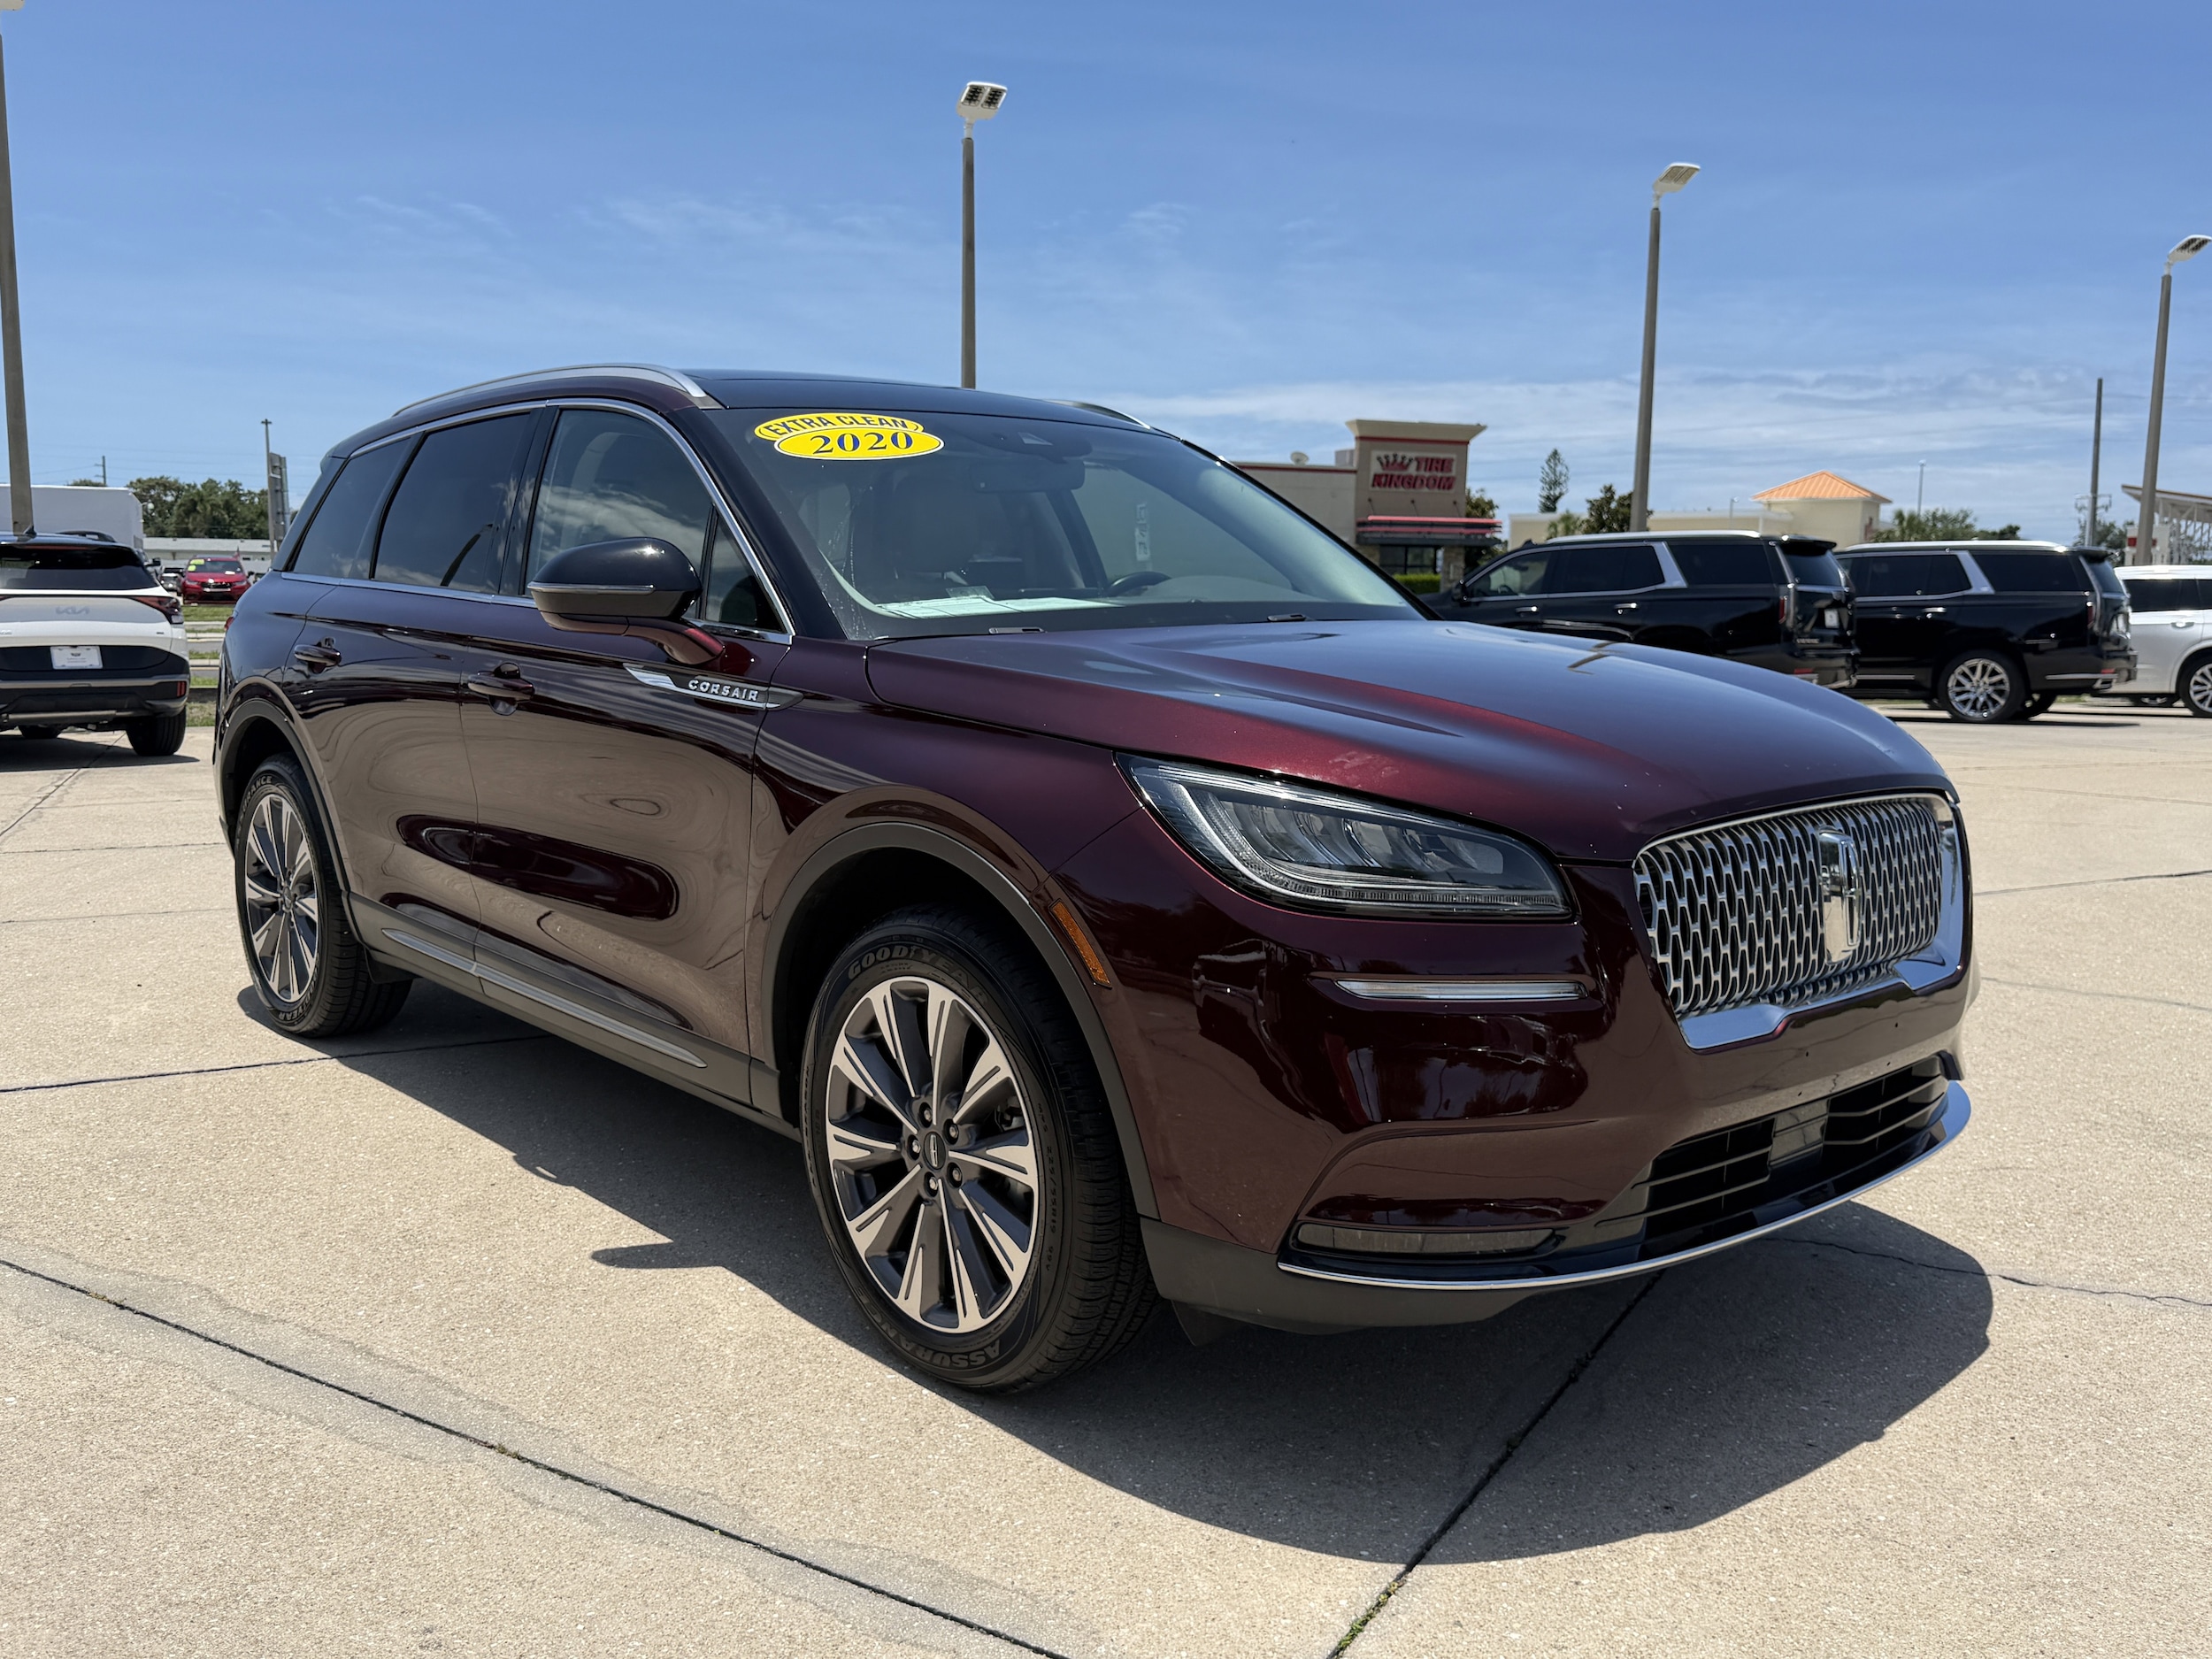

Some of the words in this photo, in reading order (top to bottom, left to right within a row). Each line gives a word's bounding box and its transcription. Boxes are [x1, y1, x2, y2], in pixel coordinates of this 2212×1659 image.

[764, 416, 834, 435] EXTRA
[835, 415, 908, 429] CLEAN
[810, 432, 913, 454] 2020
[1415, 457, 1454, 472] TIRE
[1371, 473, 1455, 490] KINGDOM
[688, 680, 758, 701] CORSAIR
[848, 944, 989, 1004] GOODYEAR
[852, 1286, 1001, 1368] ASSURANCE
